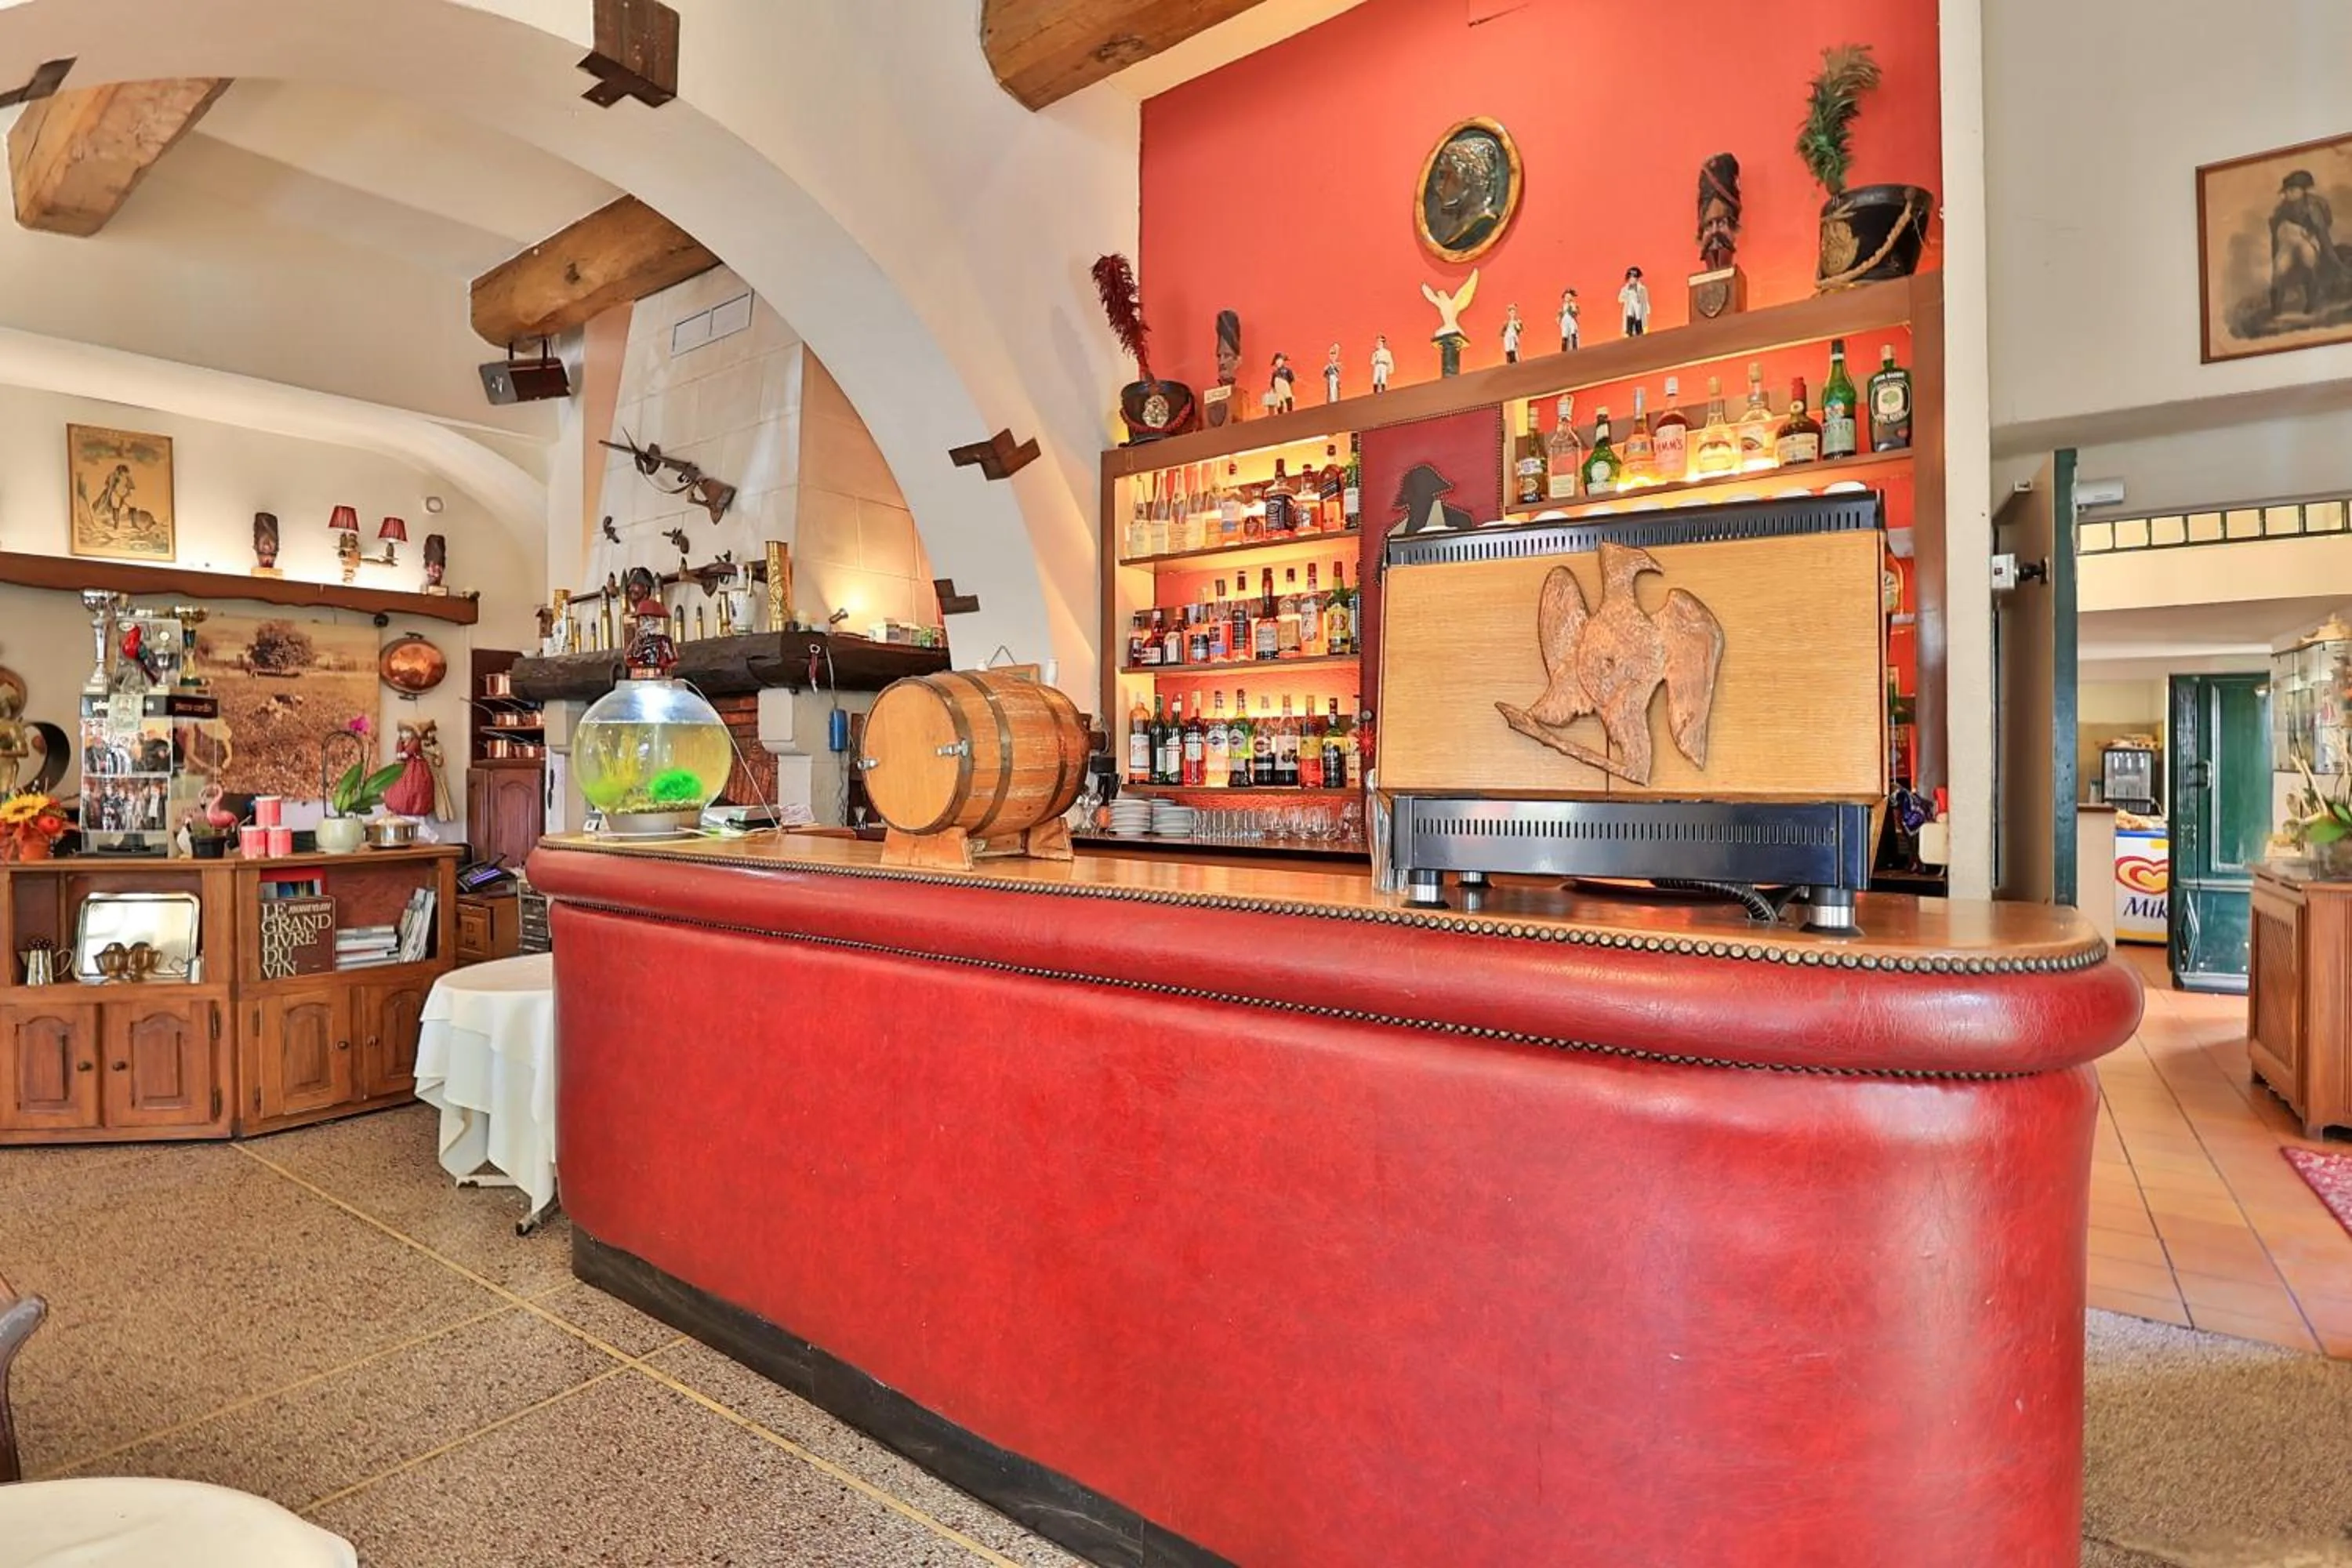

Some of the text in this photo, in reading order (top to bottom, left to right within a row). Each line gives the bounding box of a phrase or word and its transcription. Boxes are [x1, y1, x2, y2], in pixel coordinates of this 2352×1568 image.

[261, 902, 287, 920] LE
[261, 913, 332, 935] GRAND
[263, 930, 318, 950] LIVRE
[263, 946, 292, 965] DU
[262, 960, 297, 979] VIN
